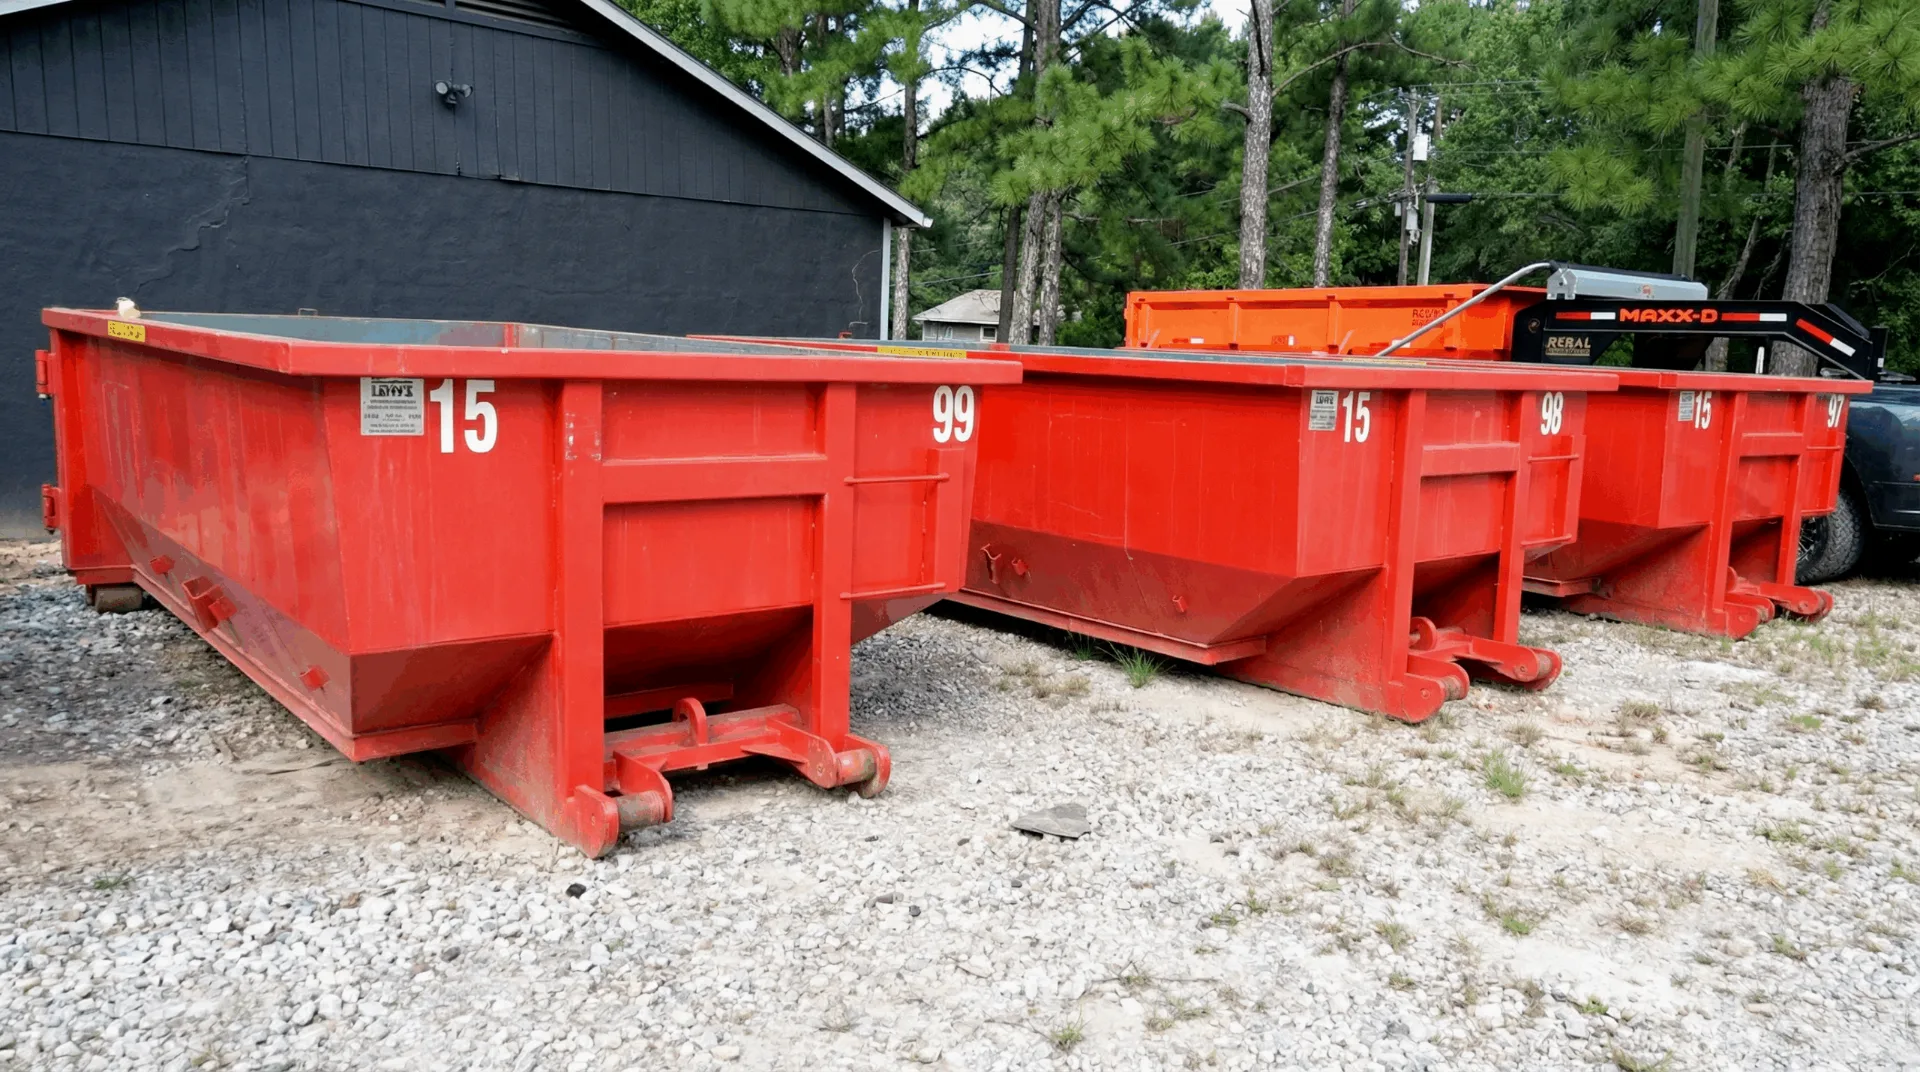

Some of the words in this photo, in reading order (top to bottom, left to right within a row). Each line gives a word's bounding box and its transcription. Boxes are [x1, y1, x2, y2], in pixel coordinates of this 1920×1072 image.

[1619, 308, 1718, 323] MAXX-D
[429, 378, 498, 454] 15
[932, 385, 975, 443] 99
[1342, 390, 1371, 443] 15
[1540, 391, 1564, 436] 98
[1694, 390, 1712, 430] 15
[1827, 394, 1845, 428] 97
